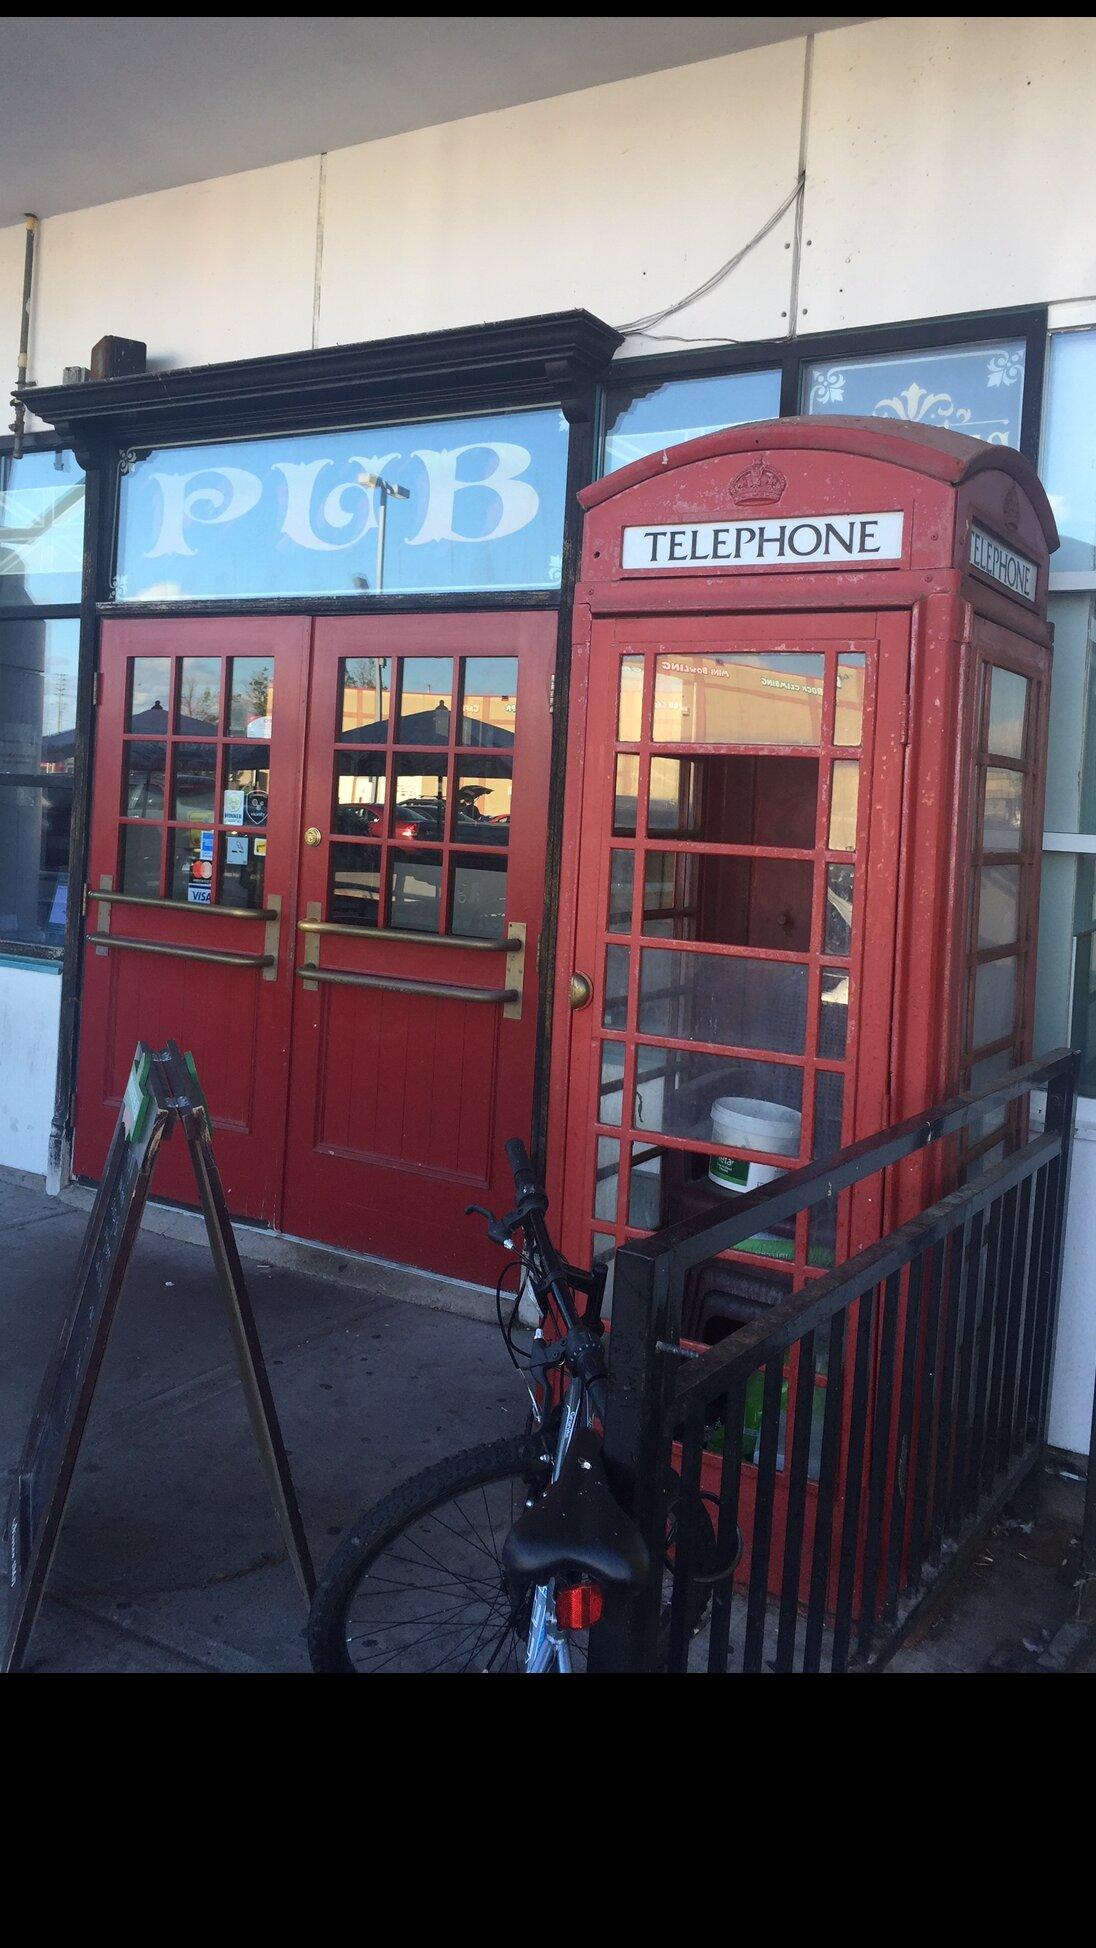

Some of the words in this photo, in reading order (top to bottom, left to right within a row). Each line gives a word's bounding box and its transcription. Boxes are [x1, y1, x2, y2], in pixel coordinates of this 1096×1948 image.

[144, 441, 540, 559] PUB
[644, 519, 881, 562] TELEPHONE
[192, 890, 211, 901] VISA
